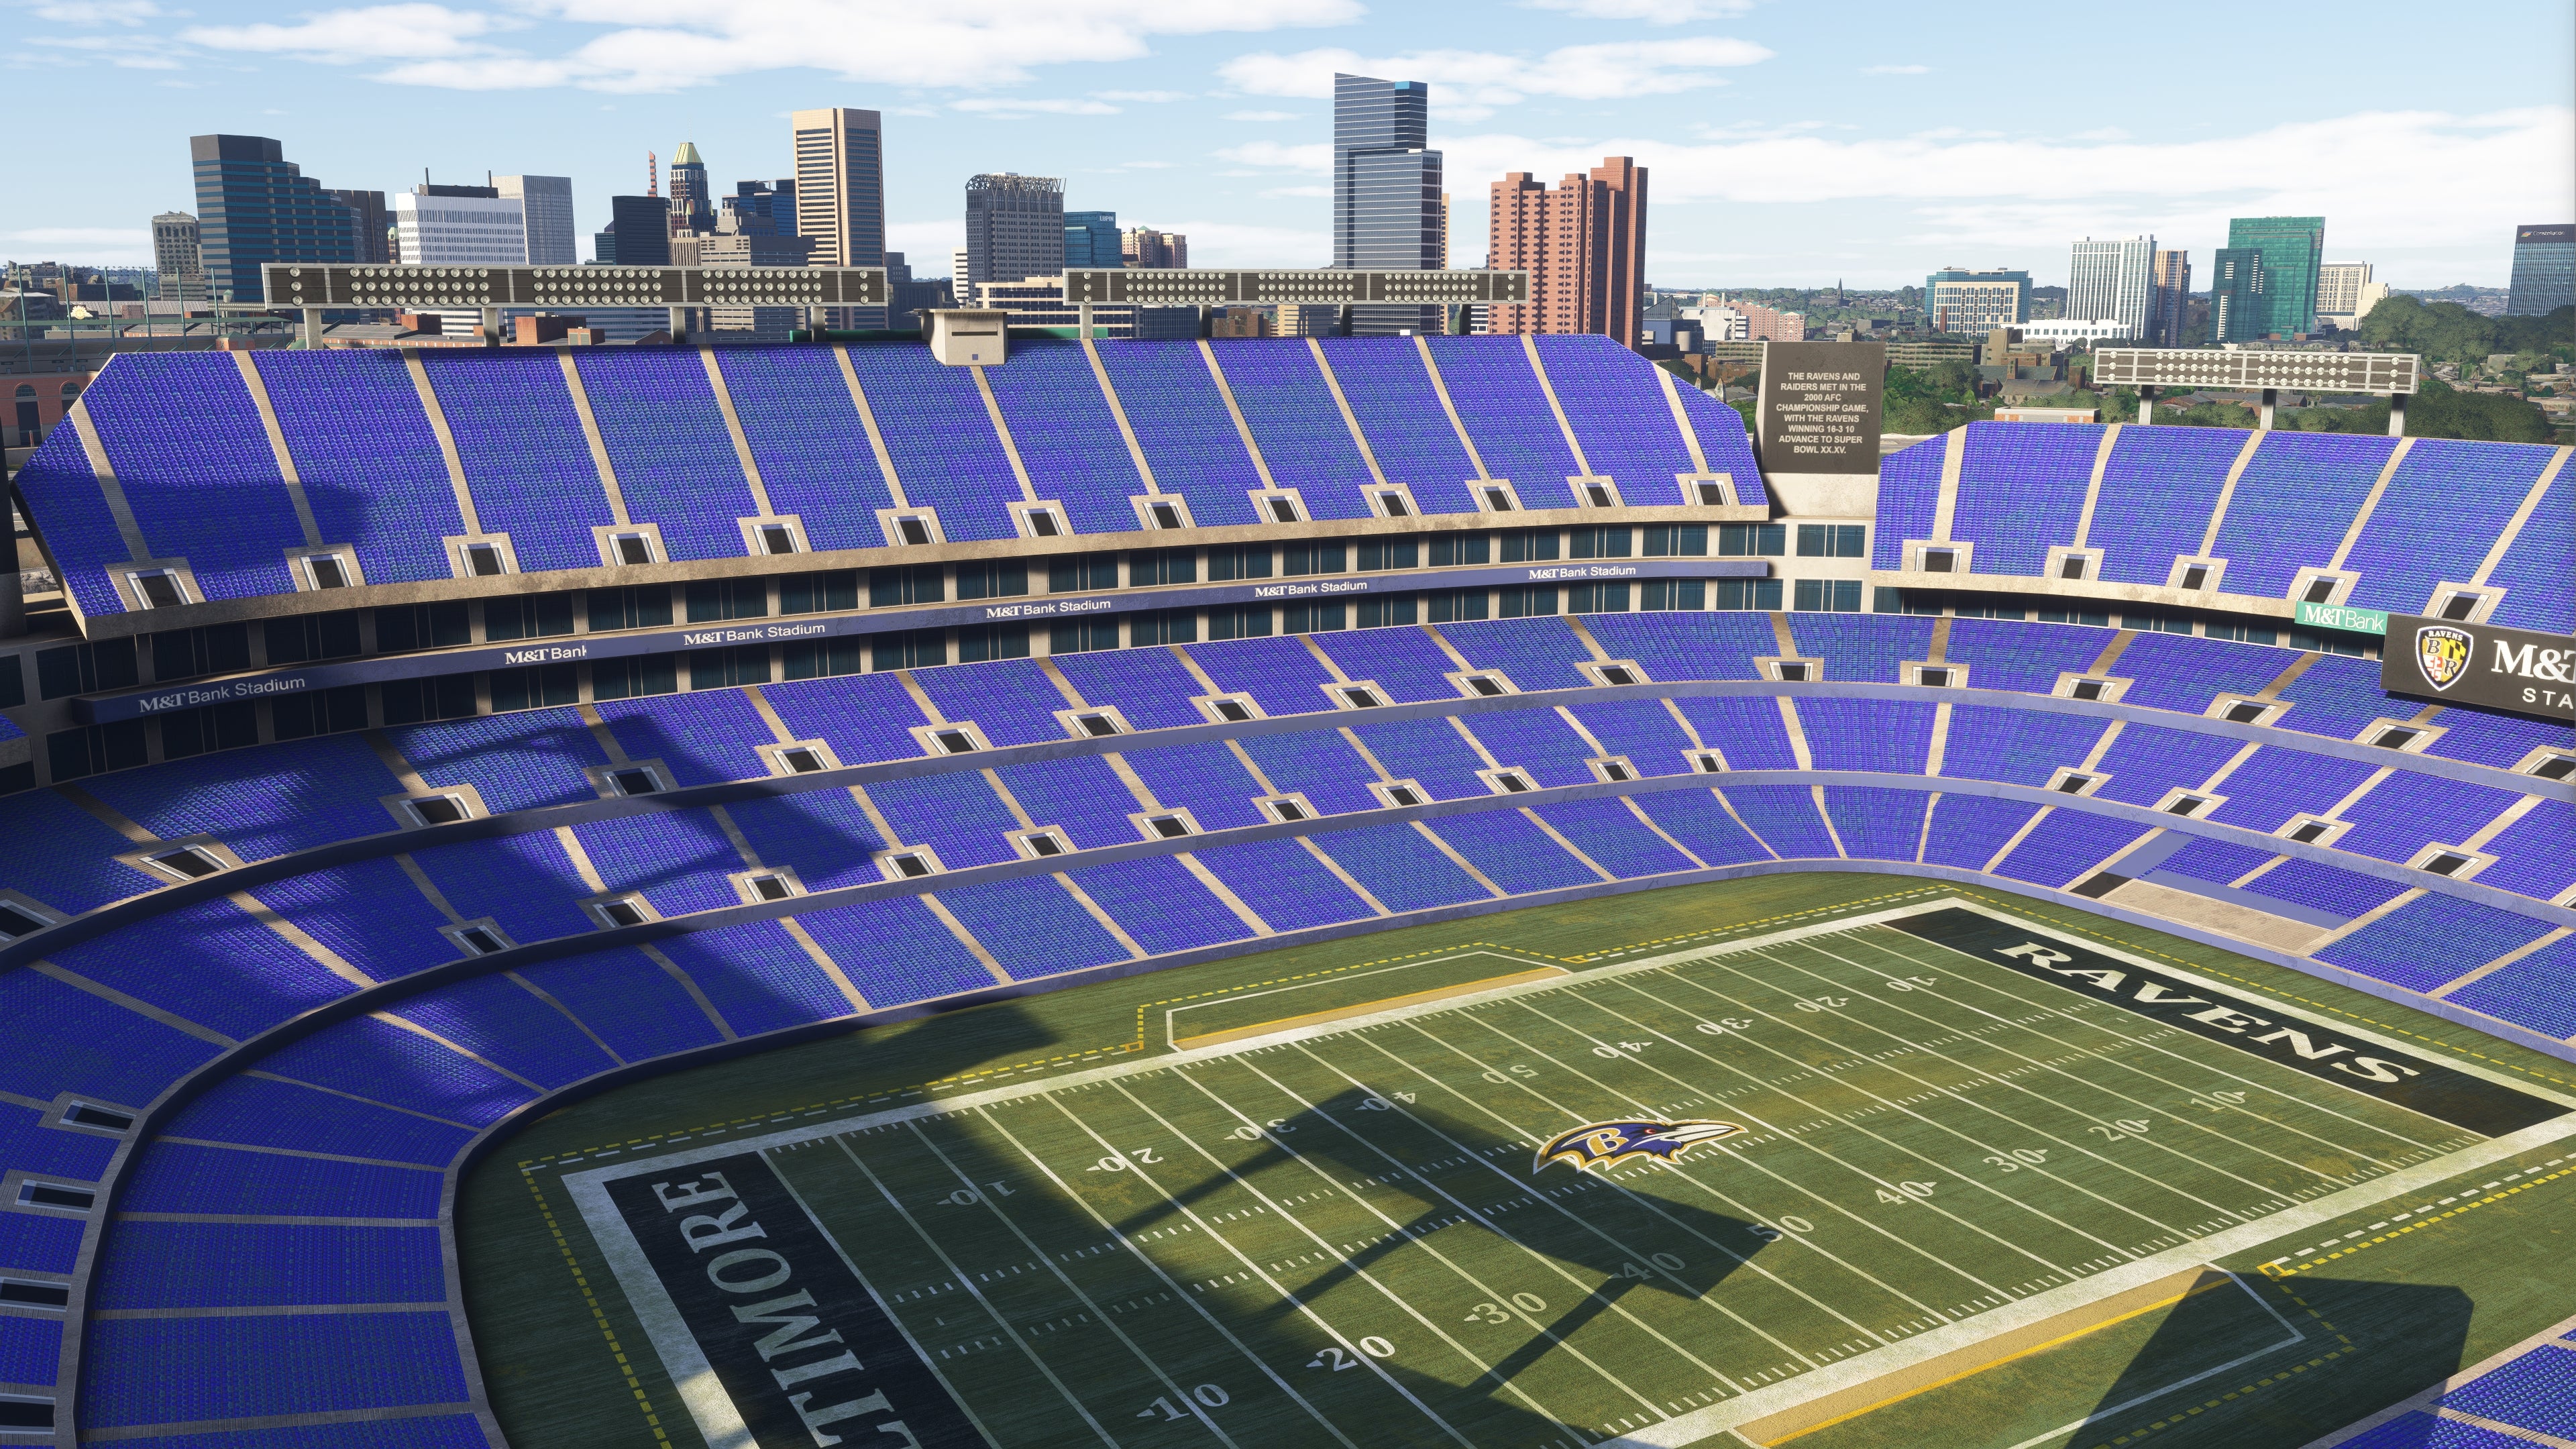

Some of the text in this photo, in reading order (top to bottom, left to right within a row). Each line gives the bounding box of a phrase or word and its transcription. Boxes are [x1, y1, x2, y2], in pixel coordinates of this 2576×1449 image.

[1788, 372, 1860, 380] THE RAVENS AND
[1776, 404, 1869, 413] CHAMPIONSHIP GAME,
[1788, 425, 1824, 433] WINNING
[1794, 445, 1819, 453] BOWL
[1529, 566, 1636, 580] M&T Bank Stadium
[1254, 582, 1367, 597] M&T Bank Stadium
[986, 600, 1111, 619] M&T Bank Stadium
[2304, 605, 2384, 632] M&T Bank
[684, 624, 825, 645] M&T Bank Stadium
[2428, 631, 2463, 641] RAVENS
[2424, 636, 2440, 655] B
[504, 649, 549, 665] M&T
[2444, 658, 2458, 677] R
[138, 678, 305, 712] M&T Bank Stadium
[1886, 976, 1934, 991] 10
[1794, 996, 1846, 1012] 20
[1994, 941, 2420, 1083] RAVENS
[1695, 1018, 1750, 1035] 30
[1592, 1040, 1643, 1059] 40
[1482, 1065, 1539, 1083] 50
[1362, 1091, 1415, 1111] 40
[2190, 1091, 2246, 1112] 10
[1234, 1118, 1297, 1140] 30
[2088, 1119, 2149, 1142] 20
[1576, 1128, 1629, 1157] B
[1098, 1148, 1164, 1171] 20
[1982, 1148, 2046, 1173] 30
[950, 1180, 1016, 1205] 10
[1875, 1181, 1934, 1205] 40
[1746, 1215, 1815, 1242] 50
[1623, 1252, 1686, 1281] 40
[1471, 1292, 1547, 1324] 30
[1317, 1336, 1395, 1372] 20
[1149, 1383, 1230, 1422] 10
